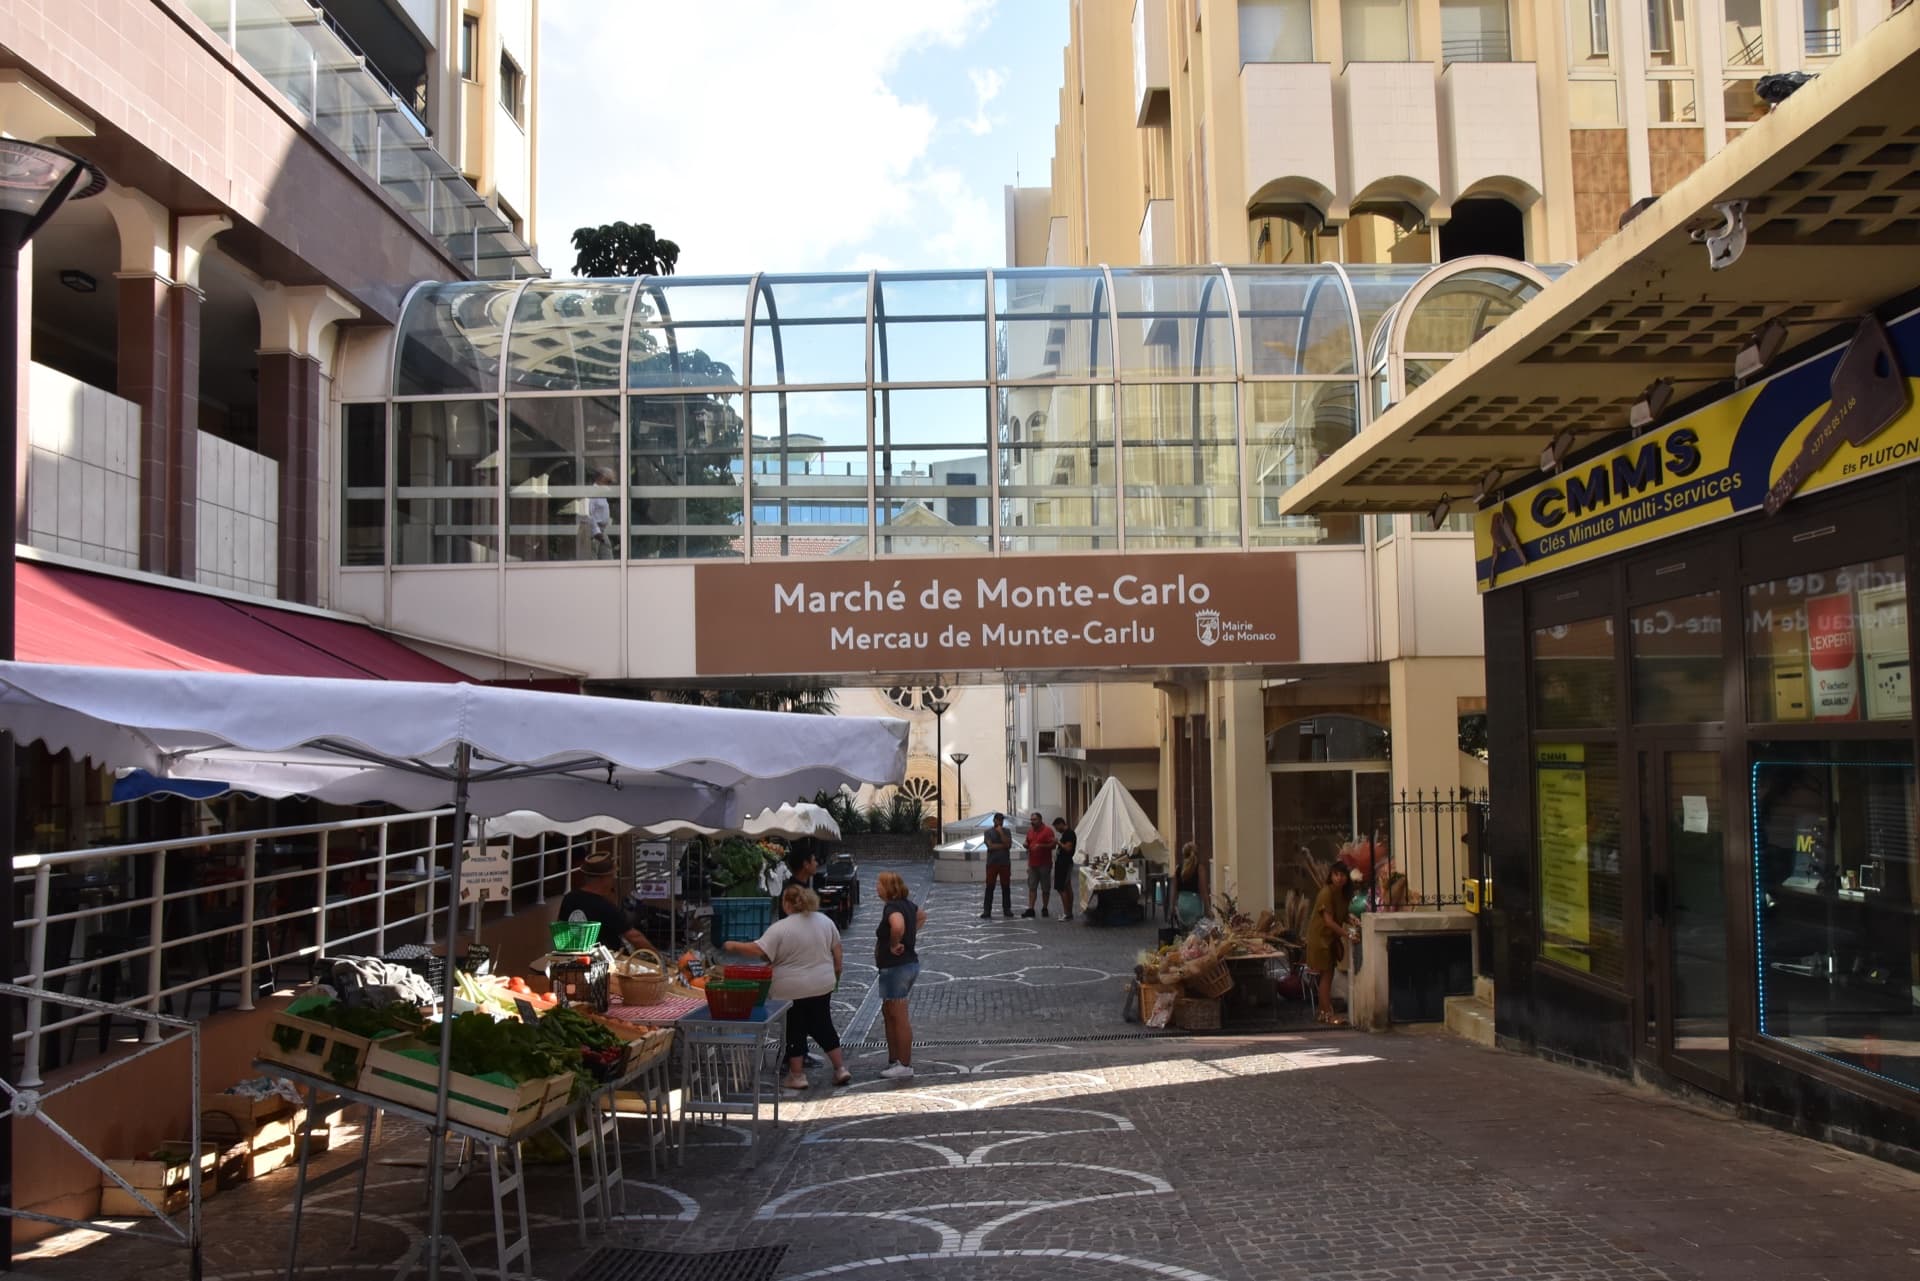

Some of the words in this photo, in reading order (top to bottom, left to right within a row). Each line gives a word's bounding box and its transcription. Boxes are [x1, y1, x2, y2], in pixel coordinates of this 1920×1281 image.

[1531, 428, 1700, 528] CMMS
[1842, 463, 1857, 475] Ets
[1539, 534, 1566, 555] Clés
[1569, 516, 1615, 546] Minute
[1618, 470, 1742, 527] Multi-Services
[774, 579, 905, 614] Marché
[920, 579, 963, 611] de
[977, 573, 1210, 610] Monte-Carlo
[830, 625, 929, 652] Mercau
[938, 624, 971, 649] de
[981, 620, 1156, 647] Munte-Carlu
[1222, 620, 1254, 631] Mairie
[1222, 631, 1235, 642] de
[1237, 631, 1277, 641] Monaco
[1810, 632, 1852, 651] L'EXPERT
